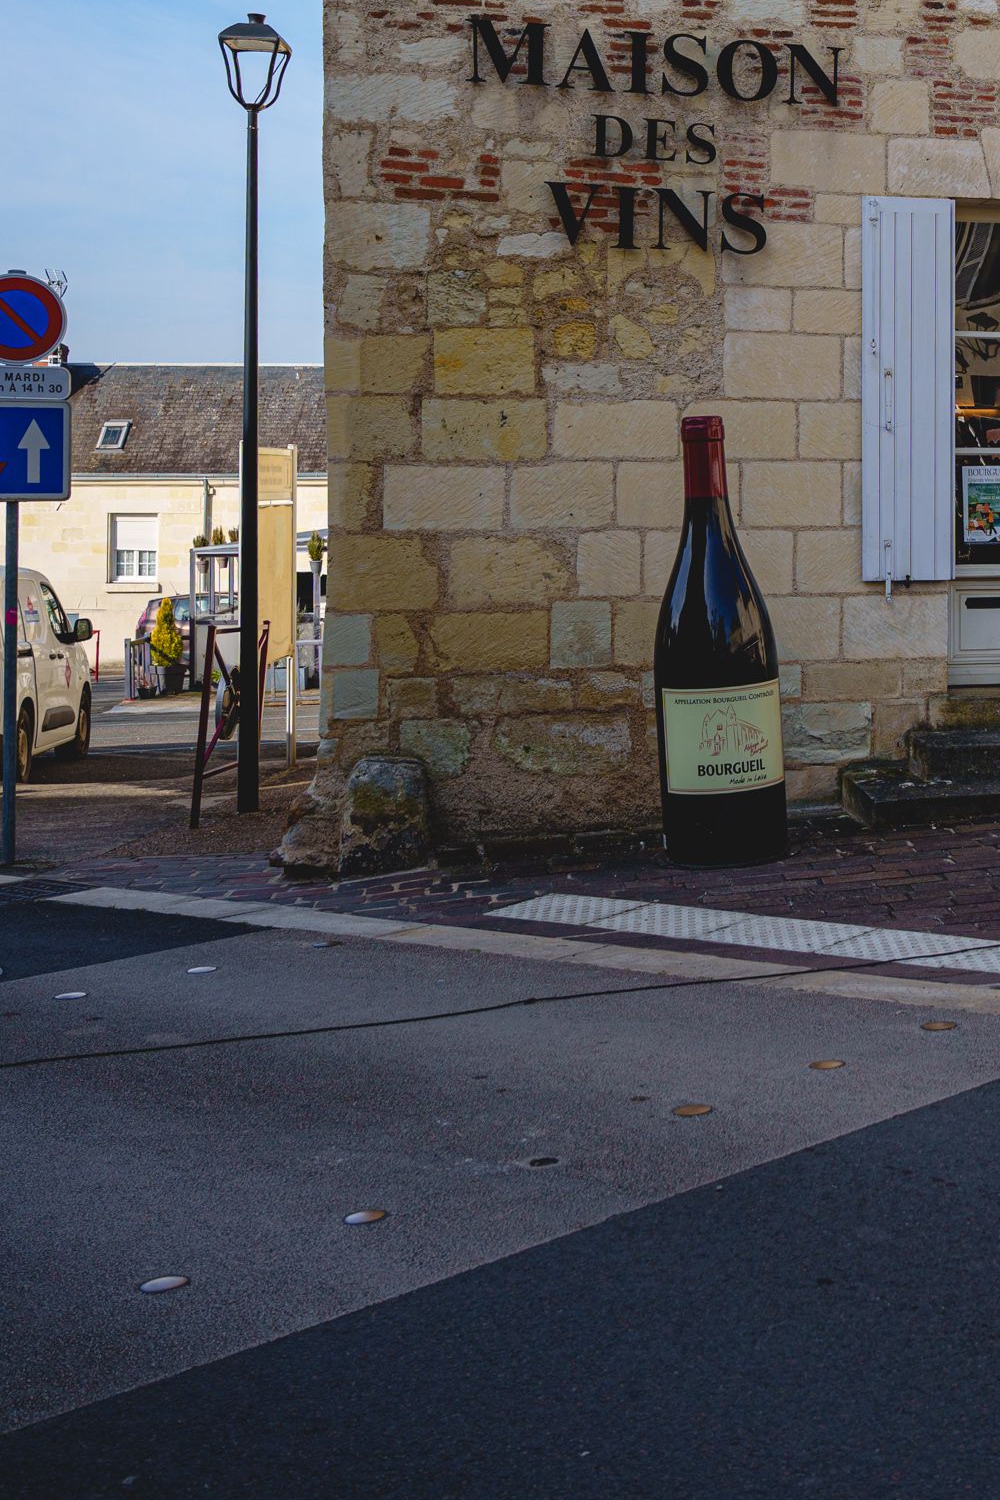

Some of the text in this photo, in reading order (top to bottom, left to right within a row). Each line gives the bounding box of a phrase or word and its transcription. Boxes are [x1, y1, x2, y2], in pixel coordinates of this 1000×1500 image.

[465, 17, 844, 107] MAISON
[590, 114, 717, 164] DES
[544, 181, 767, 255] VINS
[5, 372, 45, 382] MARDI
[9, 381, 16, 392] À
[22, 383, 33, 393] 14
[38, 384, 44, 393] h
[49, 384, 63, 393] 30
[713, 694, 747, 704] BOURGUEIL
[697, 758, 766, 777] BOURGUEIL
